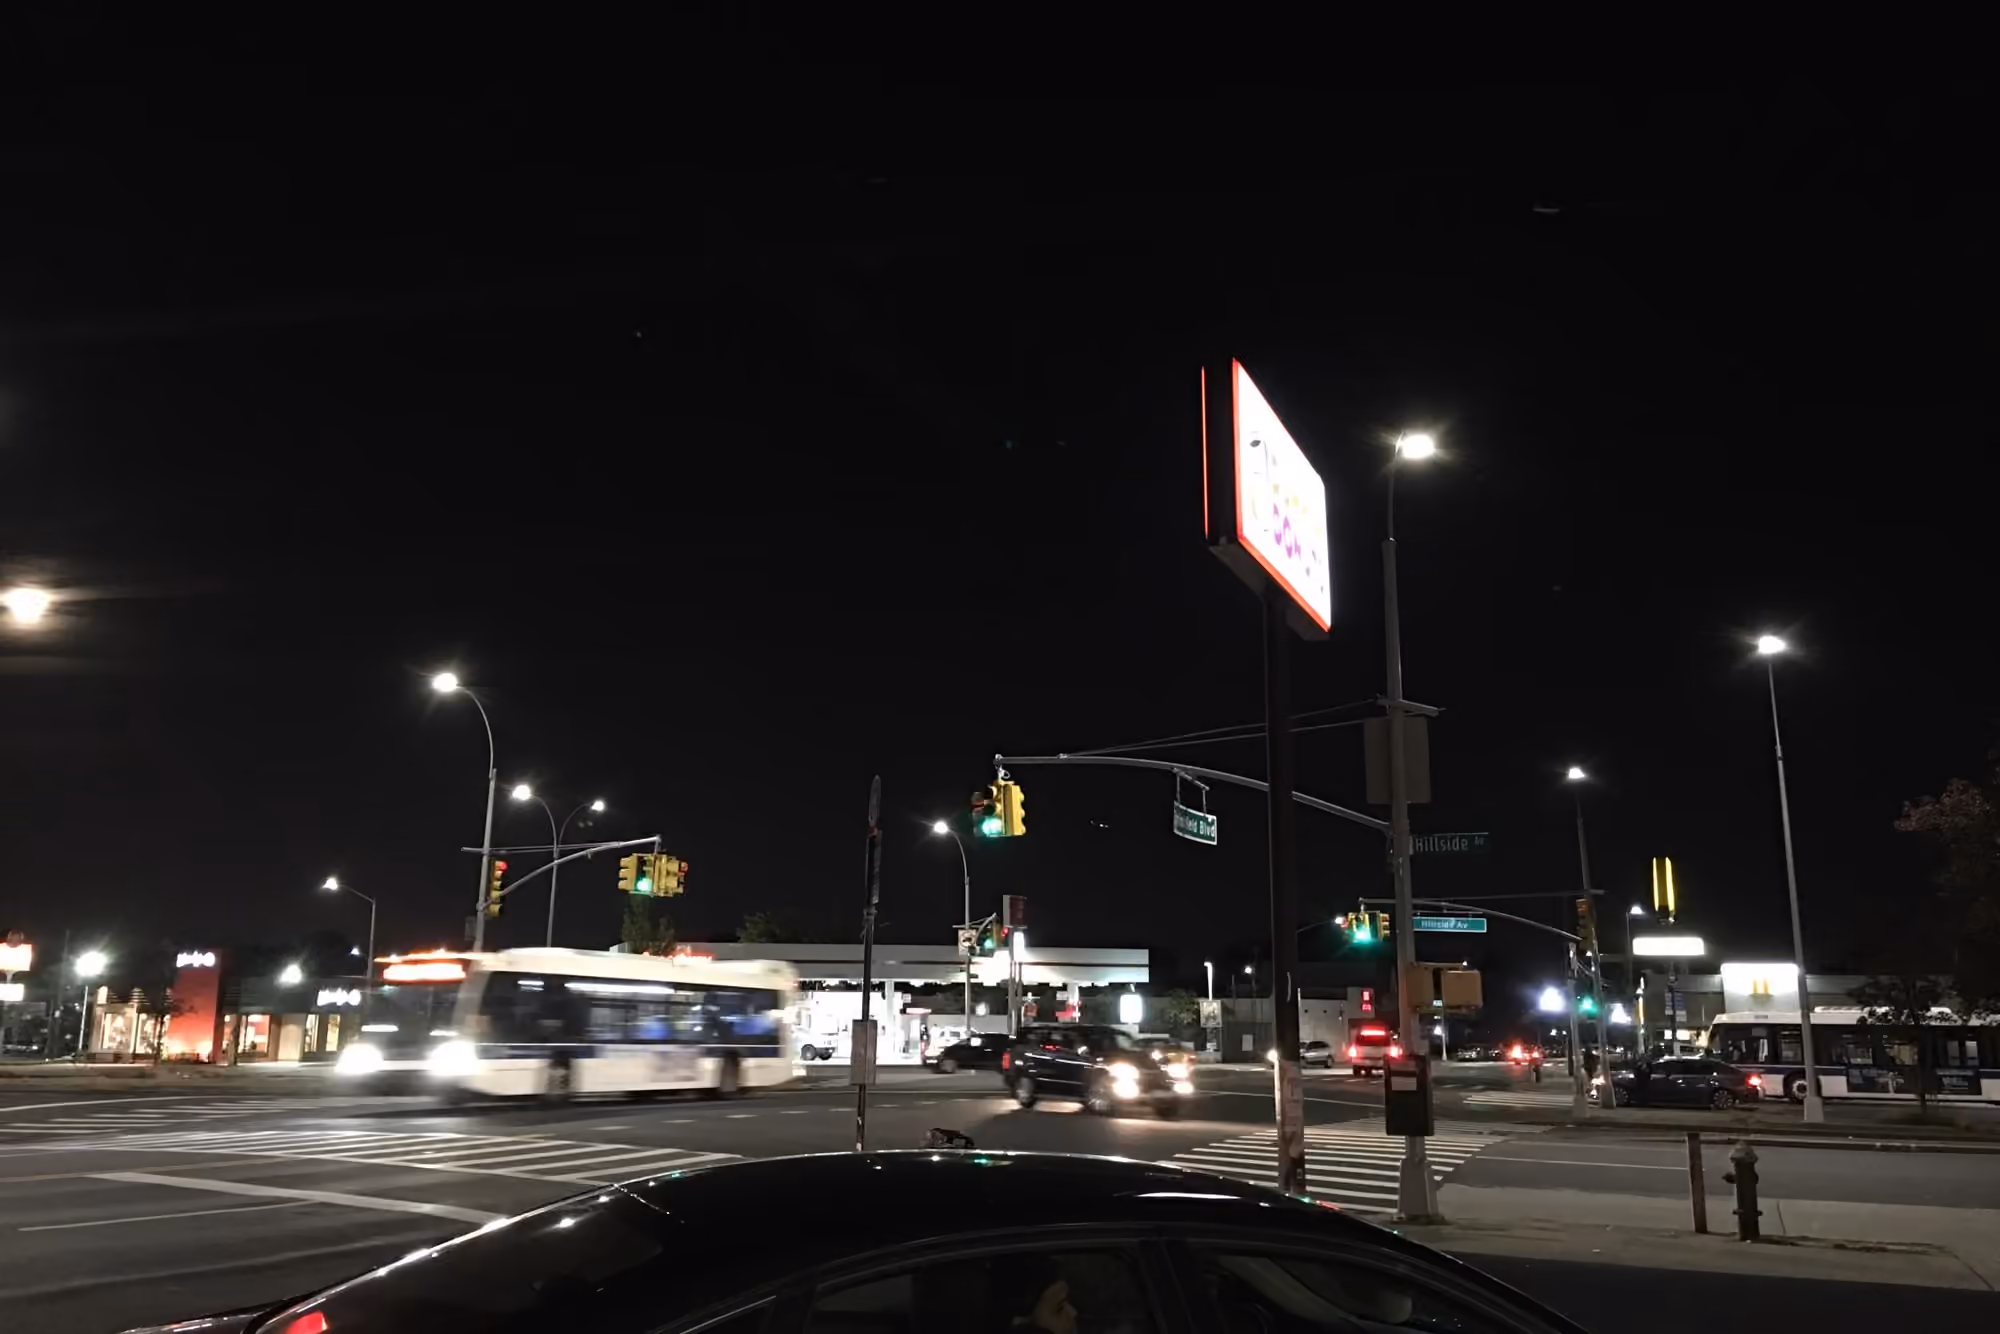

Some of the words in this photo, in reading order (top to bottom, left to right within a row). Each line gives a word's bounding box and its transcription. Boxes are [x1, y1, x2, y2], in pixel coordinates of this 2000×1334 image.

[1199, 820, 1215, 838] Blvd
[1415, 835, 1469, 852] Hillside
[1456, 920, 1469, 929] Av
